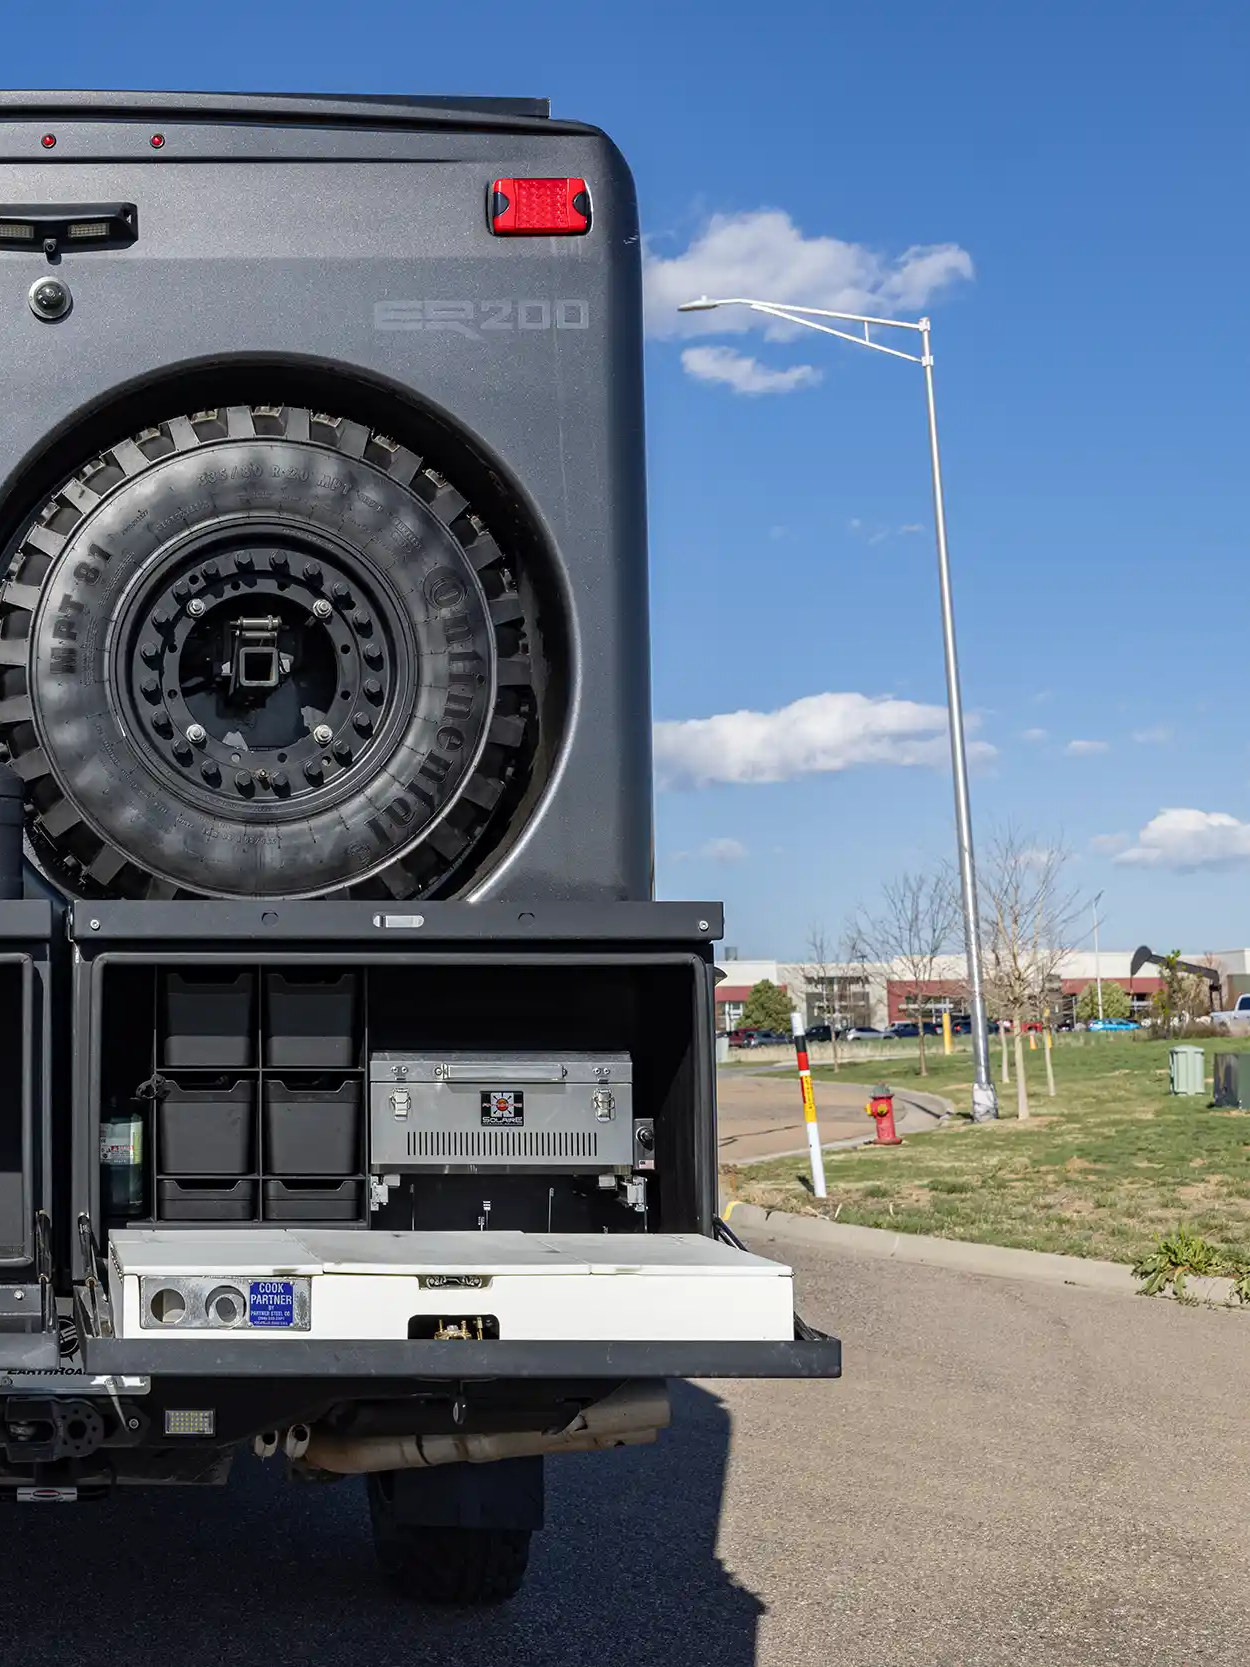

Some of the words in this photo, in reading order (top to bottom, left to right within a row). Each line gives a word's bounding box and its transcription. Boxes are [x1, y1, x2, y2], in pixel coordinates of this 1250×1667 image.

[50, 593, 86, 675] MPT
[73, 543, 113, 586] 81
[259, 1283, 284, 1293] COOK
[250, 1294, 293, 1305] PARTNER
